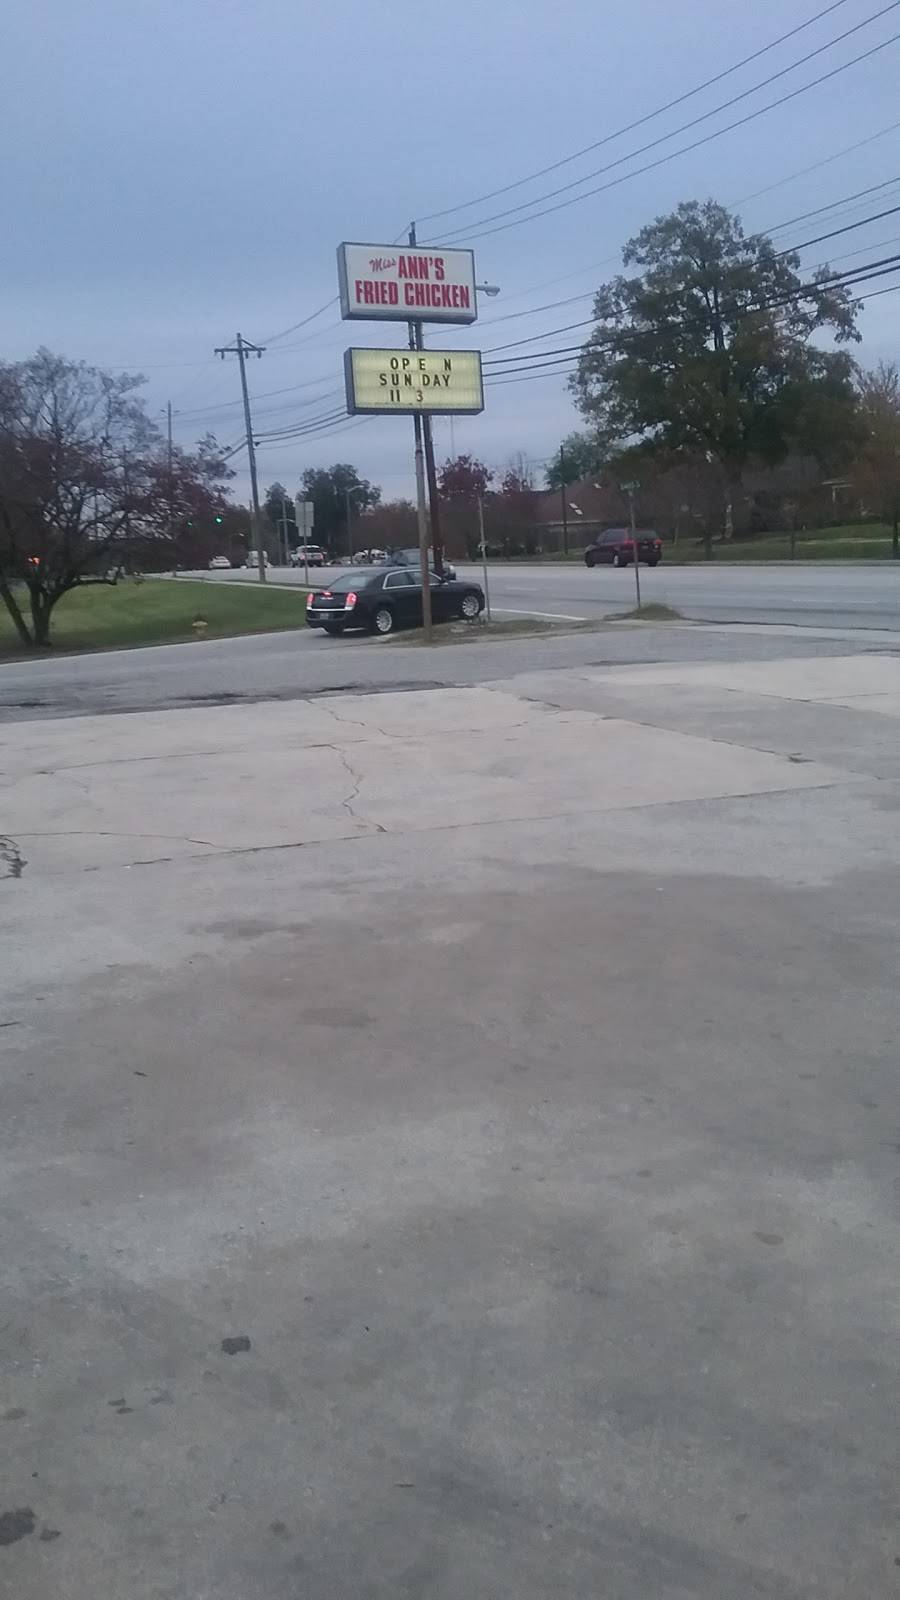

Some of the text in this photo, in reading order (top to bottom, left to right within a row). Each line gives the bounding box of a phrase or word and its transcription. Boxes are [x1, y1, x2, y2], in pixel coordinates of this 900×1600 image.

[369, 255, 446, 280] Miss ANN'S
[355, 280, 471, 308] FRIED CHICKEN
[379, 373, 451, 387] SUNDAY
[416, 390, 424, 402] 3
